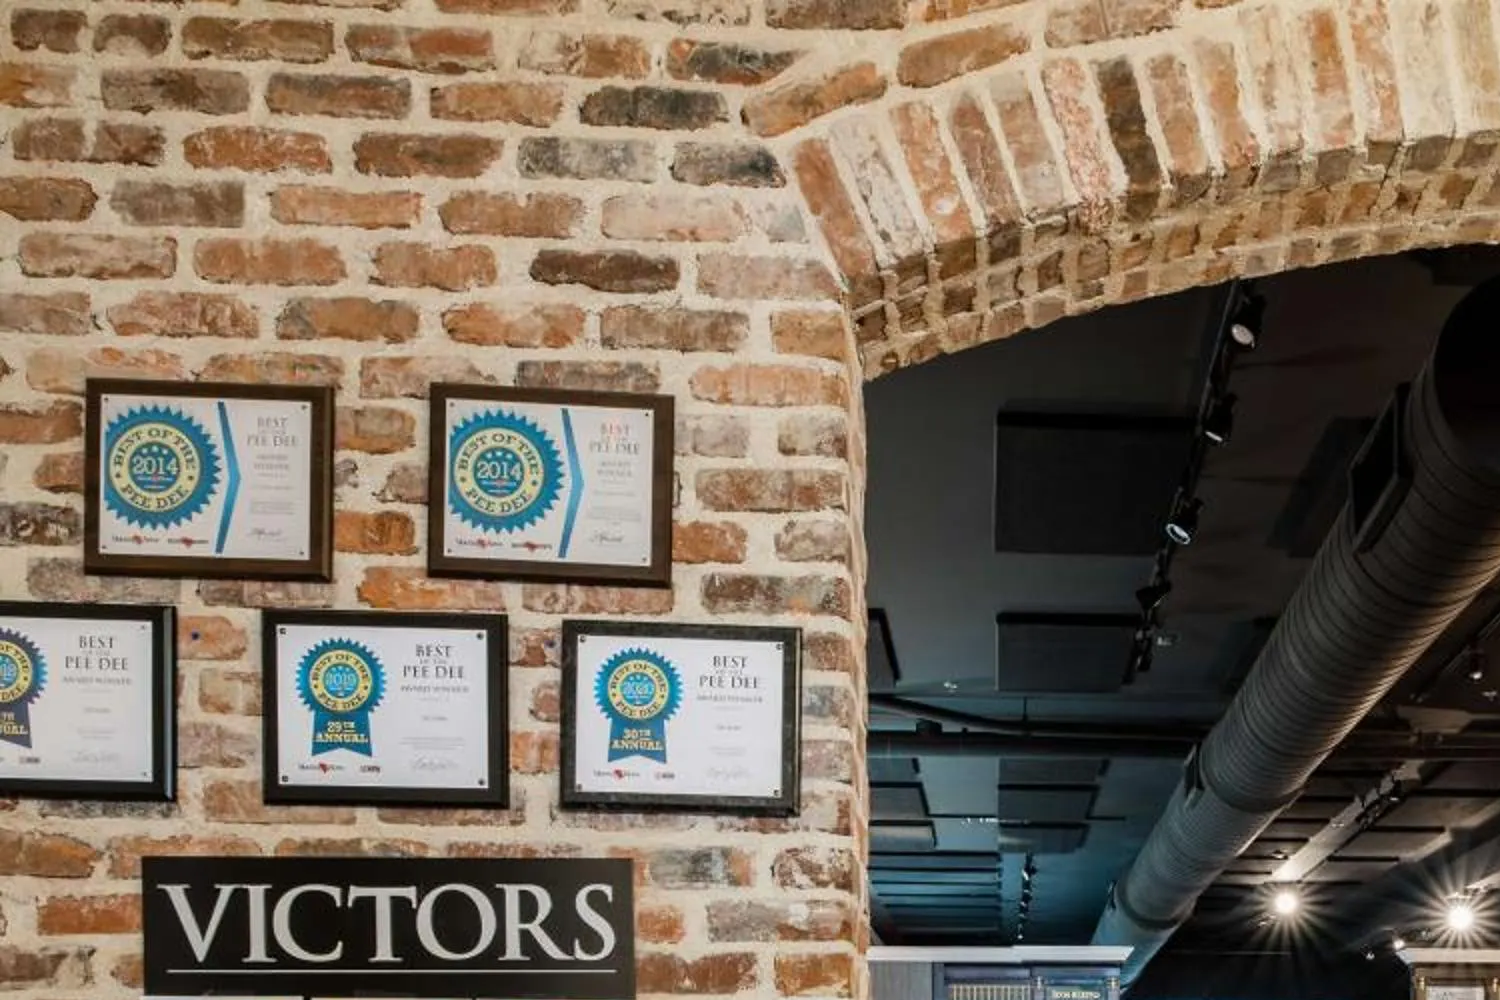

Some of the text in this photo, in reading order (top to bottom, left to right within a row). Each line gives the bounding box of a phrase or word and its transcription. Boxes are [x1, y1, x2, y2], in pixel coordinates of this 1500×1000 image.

[114, 427, 197, 471] BEST OF THE
[458, 433, 539, 475] BEST OF THE
[131, 455, 178, 475] 2014
[477, 461, 522, 480] 2014
[121, 484, 190, 508] PEE DEE
[466, 488, 532, 512] PEE DEE
[79, 635, 115, 649] BEST
[415, 644, 452, 657] BEST
[65, 655, 129, 671] PEE DEE
[713, 655, 748, 668] BEST
[403, 665, 464, 679] PEE DEE
[699, 674, 759, 689] PEE DEE
[315, 732, 369, 743] ANNUAL
[611, 739, 664, 751] ANNUAL
[157, 882, 616, 964] VICTORS
